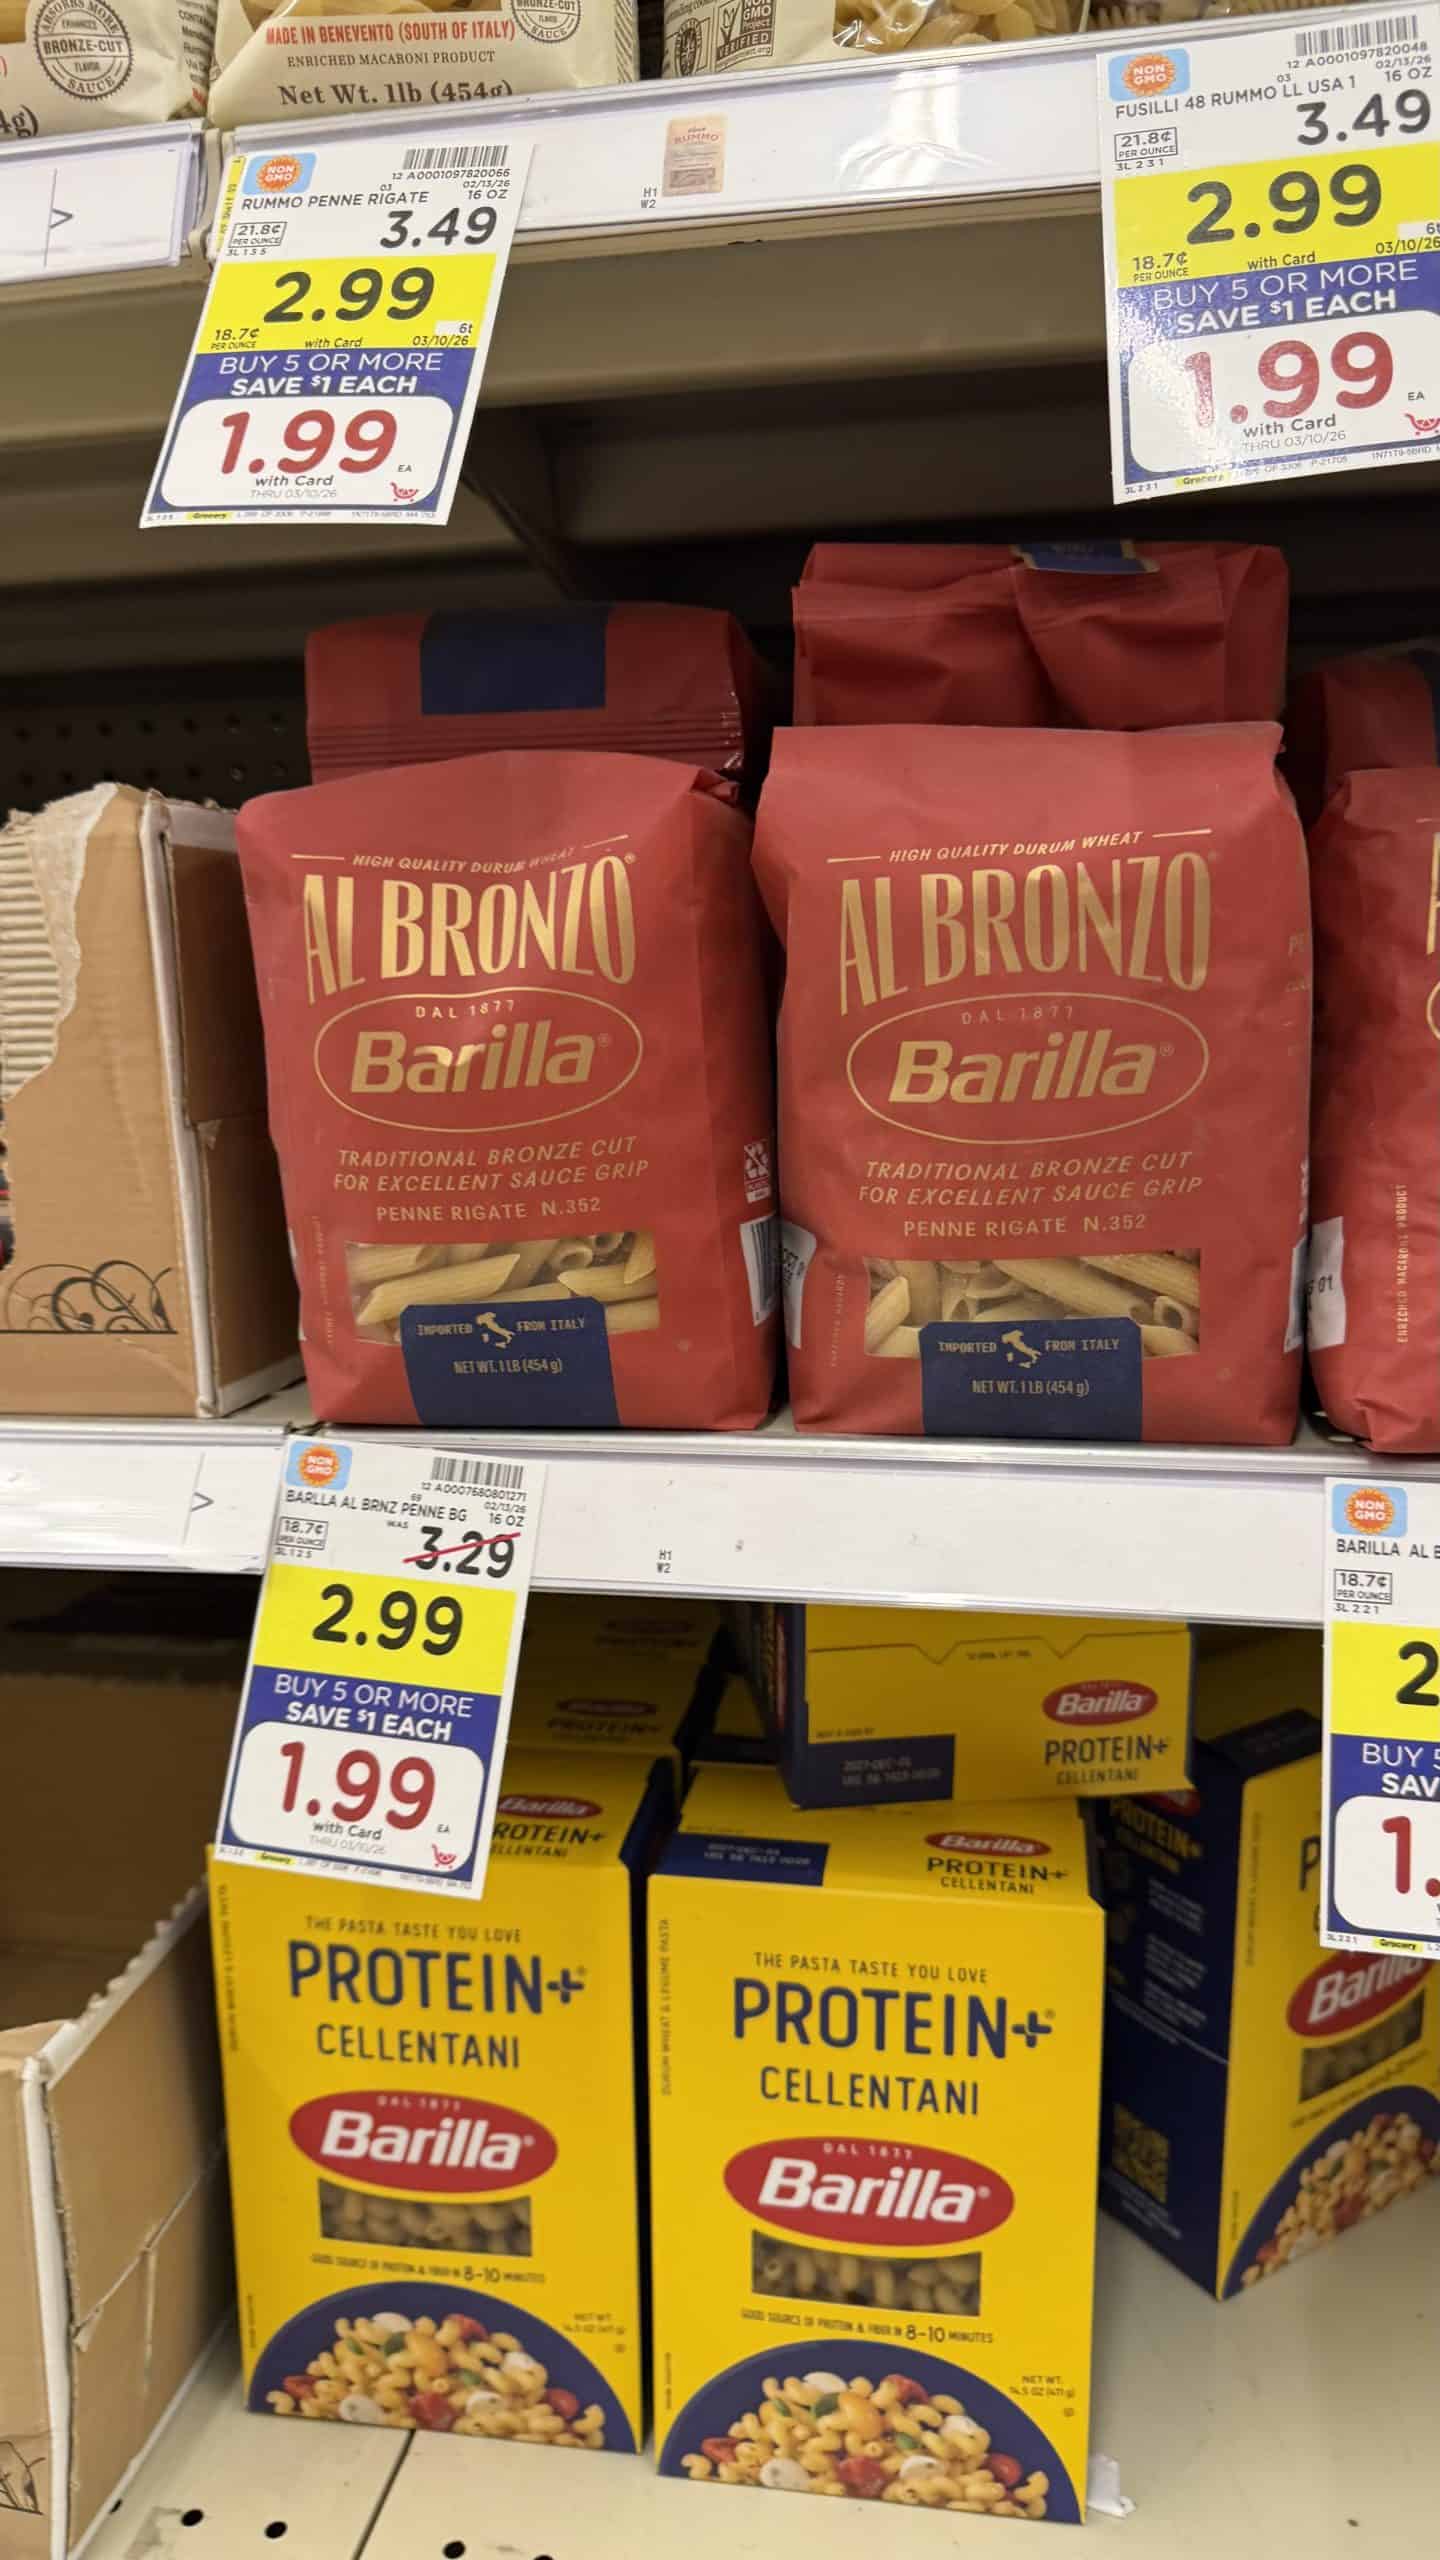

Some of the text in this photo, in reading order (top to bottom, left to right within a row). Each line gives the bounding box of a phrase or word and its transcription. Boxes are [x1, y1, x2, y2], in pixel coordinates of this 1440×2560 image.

[88, 0, 120, 34] MORE
[744, 5, 771, 20] GMO
[266, 19, 515, 44] MADE IN BENEVENTO (SOUTH OF ITALY)
[43, 39, 123, 55] BRONZE-CUT
[288, 51, 496, 68] ENRICHED MACARONI PRODUCT
[1133, 64, 1165, 75] NON
[68, 77, 115, 94] SAUCE
[1134, 72, 1167, 86] GMO
[1385, 67, 1432, 83] 16 OZ
[278, 80, 513, 105] Net Wt. 1lb (454g)
[1115, 75, 1356, 119] FUSILLI 48 RUMMO LL USA 1
[1296, 88, 1431, 146] 3.49
[1118, 145, 1176, 159] PER OUNCE
[1121, 132, 1173, 148] 21.8¢
[264, 172, 293, 183] GMO
[267, 165, 295, 174] NON
[407, 168, 510, 181] A0001097820066
[241, 192, 429, 211] RUMMO PENNE RIGATE
[467, 189, 507, 201] 16 OZ
[643, 188, 657, 198] H1
[1187, 164, 1382, 245] 2.99
[237, 224, 281, 237] 21.8¢
[380, 206, 497, 248] 3.49
[1376, 236, 1440, 254] 03/10/26
[1133, 251, 1188, 271] 18.7¢
[1247, 251, 1316, 271] with Card
[264, 267, 434, 323] 2.99
[1154, 258, 1418, 311] BUY 5 OR MORE
[1176, 288, 1397, 334] SAVE $1 EACH
[214, 327, 259, 341] 18.7¢
[304, 336, 362, 349] with Card
[412, 335, 469, 348] 03/10/26
[220, 353, 444, 376] BUY 5 OR MORE
[231, 375, 417, 397] SAVE $1 EACH
[1184, 331, 1394, 429] 1.99
[1407, 391, 1425, 401] EA
[1243, 414, 1337, 438] with Card
[221, 409, 398, 474] 1.99
[397, 464, 412, 473] EA
[888, 831, 1144, 863] HIGH QUALITY DURUM WHEAT
[304, 855, 636, 1006] AL BRONZO
[840, 851, 1212, 1017] AL BRONZO
[961, 1004, 1074, 1026] DAL 1877
[350, 1019, 596, 1094] Barilla
[888, 1029, 1157, 1104] Barilla
[338, 1135, 637, 1168] TRADITIONAL BRONZE CUT
[865, 1151, 1192, 1181] TRADITIONAL BRONZE CUT
[858, 1176, 1203, 1207] FOR EXCELLENT SAUCE GRIP
[376, 1197, 601, 1222] PENNE RIGATE N.352
[904, 1213, 1147, 1238] PENNE RIGATE N.352
[938, 1338, 1120, 1354] IMPORTED FROM ITALY
[285, 1489, 467, 1522] BARLLA AL BRNZ PENNE BG
[1355, 1499, 1385, 1510] NON
[1355, 1510, 1386, 1521] GMO
[283, 1519, 323, 1535] 18.7¢
[489, 1513, 524, 1528] 16 OZ
[415, 1526, 515, 1579] 3.29
[1336, 1538, 1429, 1559] BARILLA AL
[1339, 1572, 1387, 1588] 18.7¢
[312, 1583, 464, 1656] 2.99
[274, 1674, 474, 1718] BUY 5 OR MORE
[1056, 1690, 1145, 1717] Barilla
[286, 1702, 452, 1742] SAVE $1 EACH
[1045, 1735, 1169, 1766] PROTEIN+
[1362, 1742, 1424, 1768] BUY
[280, 1741, 436, 1830] 1.99
[1056, 1768, 1138, 1786] CELLENTANI
[938, 1834, 1038, 1853] Barilla
[926, 1856, 1069, 1880] PROTEIN+
[940, 1876, 1034, 1894] CELLENTANI
[288, 1939, 585, 2015] PROTEIN+
[755, 1951, 987, 1984] THE PASTA TASTE YOU LOVE
[733, 1976, 1053, 2059] PROTEIN+
[316, 2023, 520, 2069] CELLENTANI
[760, 2066, 979, 2117] CELLENTANI
[320, 2109, 522, 2171] Barilla
[758, 2156, 976, 2224] Barilla
[905, 2324, 946, 2344] 8-10
